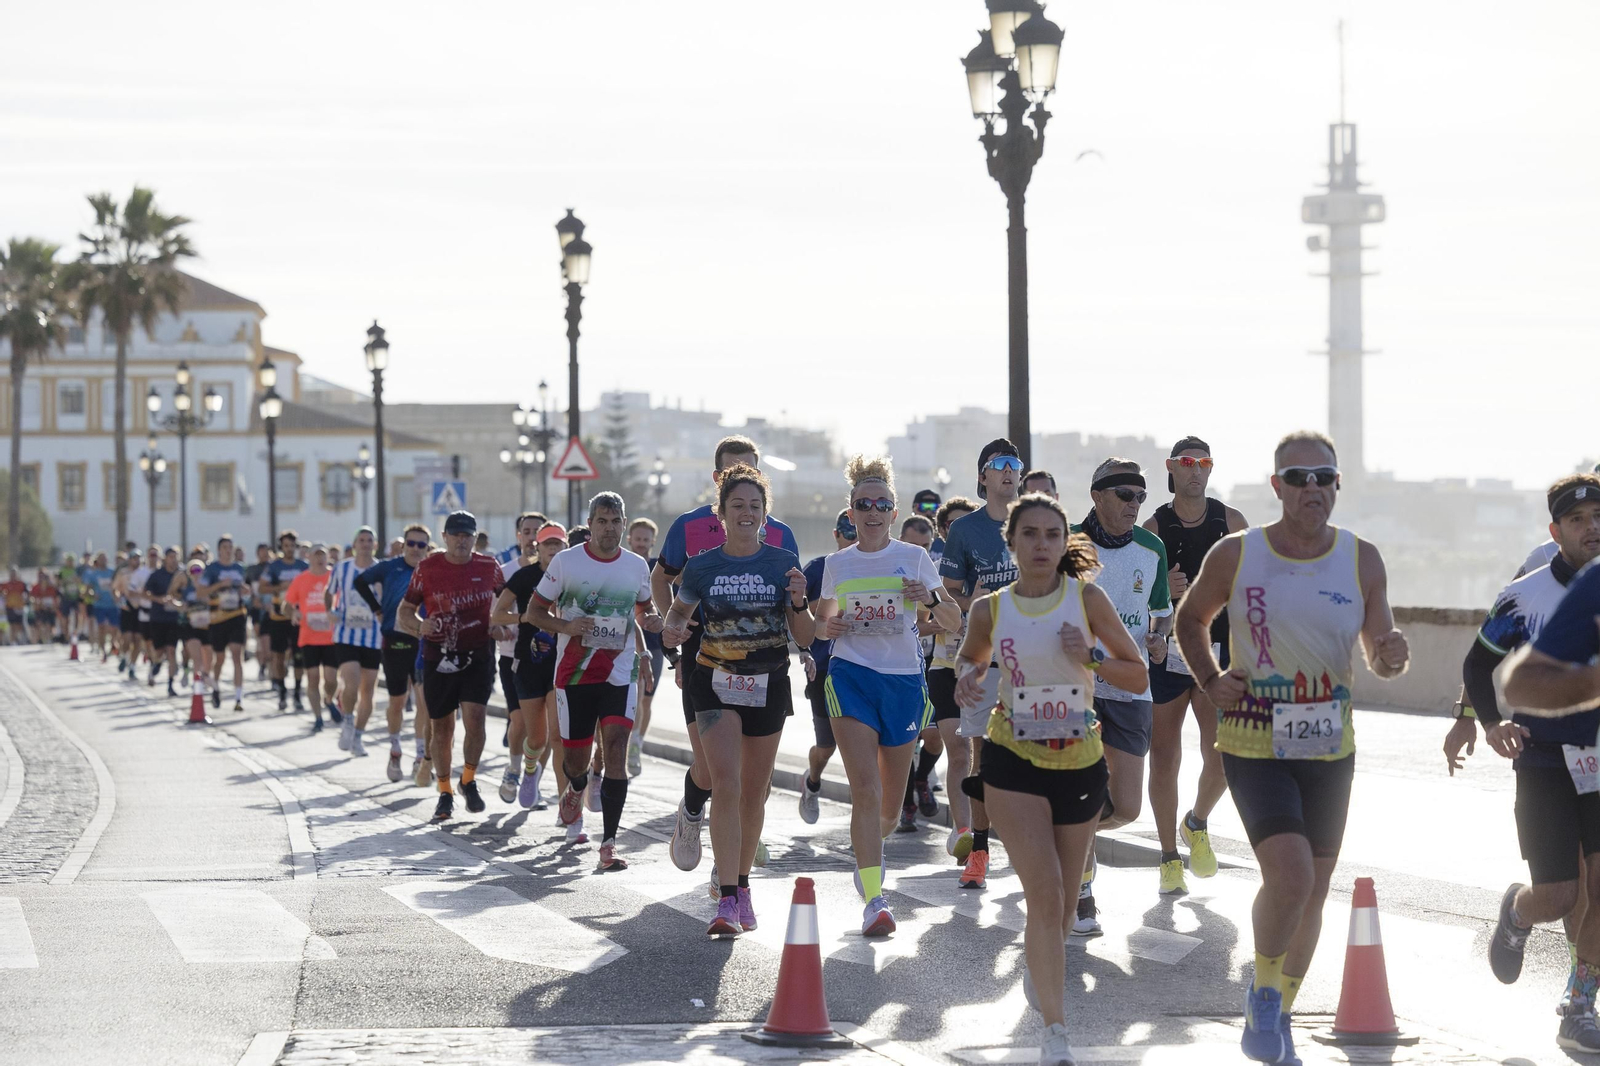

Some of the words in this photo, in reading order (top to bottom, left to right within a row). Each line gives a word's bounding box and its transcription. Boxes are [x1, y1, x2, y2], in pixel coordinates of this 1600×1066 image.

[996, 559, 1016, 571] ME
[714, 572, 764, 585] media
[978, 569, 1019, 584] MARAT
[709, 582, 776, 596] maraton
[855, 605, 896, 621] 2348
[592, 625, 616, 638] 894
[1245, 586, 1275, 669] ROMA
[1000, 637, 1025, 687] ROM
[725, 675, 755, 692] 132
[1030, 701, 1067, 721] 100
[1284, 718, 1333, 739] 1243
[1575, 755, 1599, 776] 18
